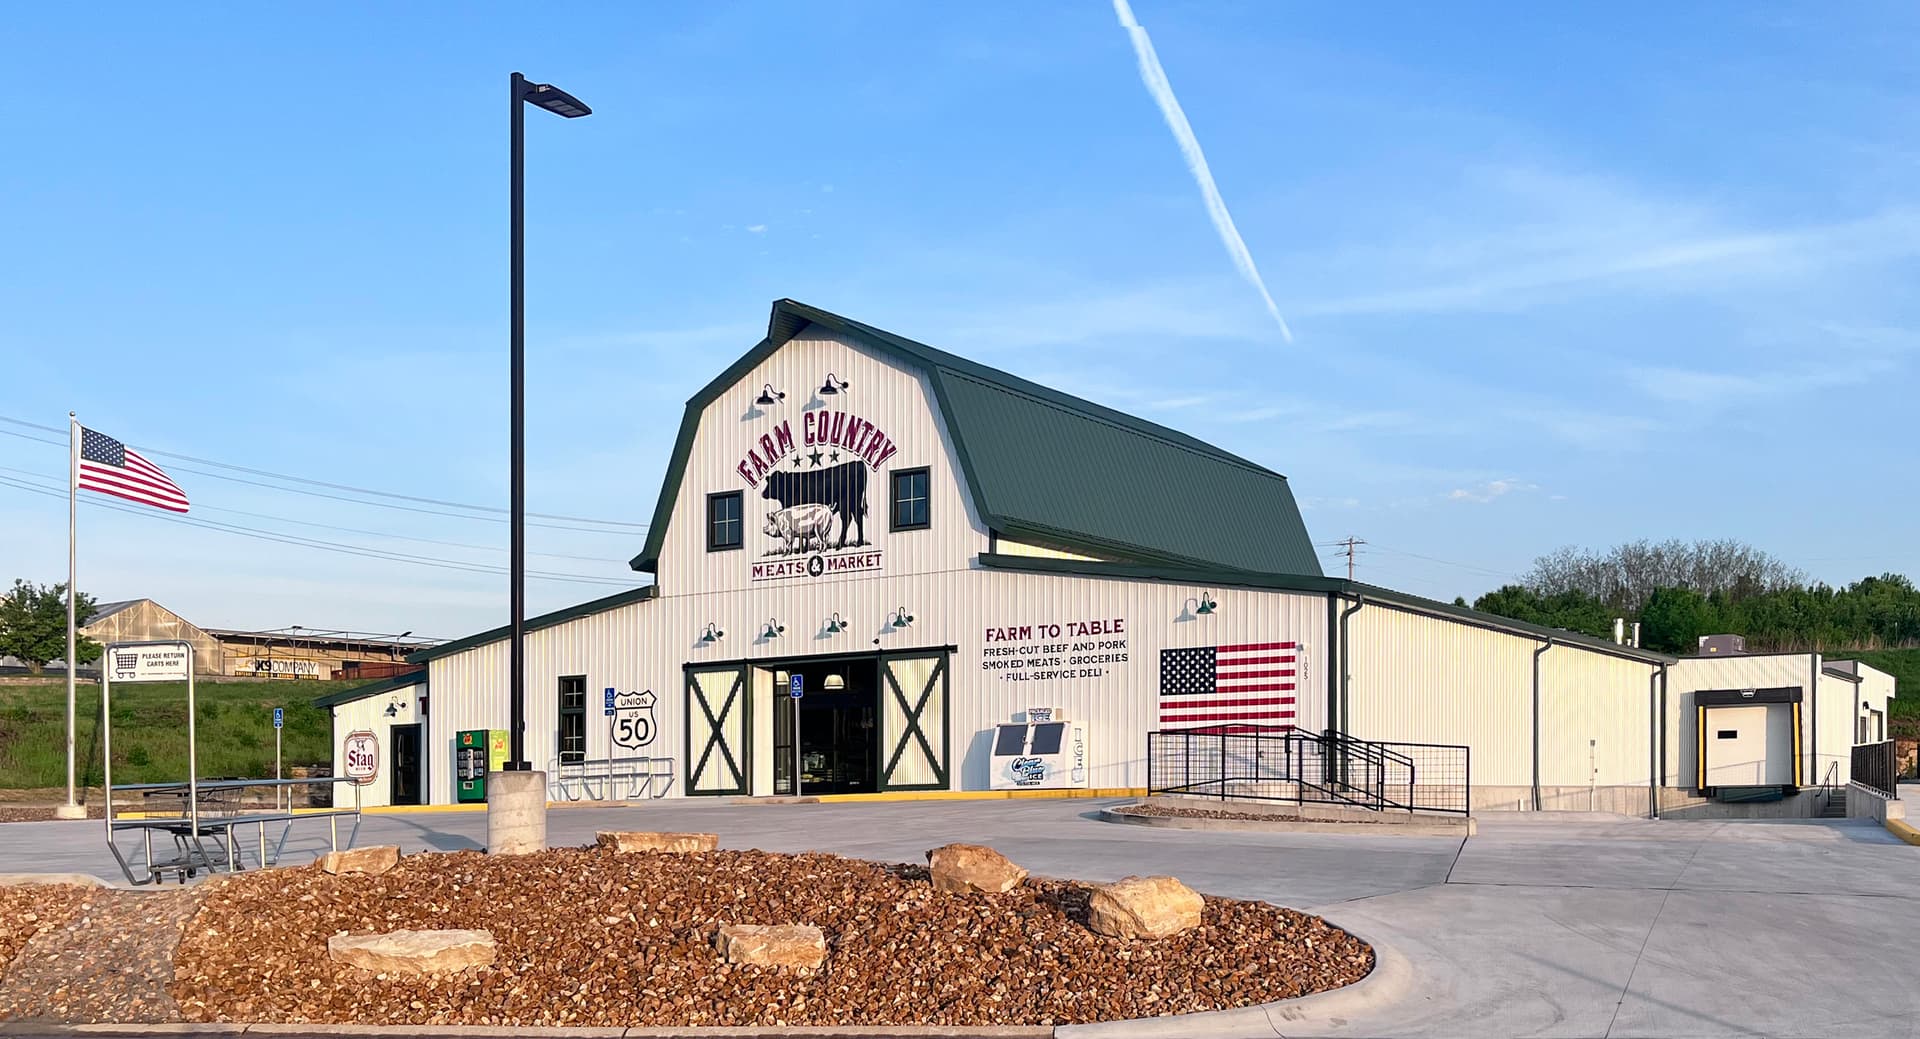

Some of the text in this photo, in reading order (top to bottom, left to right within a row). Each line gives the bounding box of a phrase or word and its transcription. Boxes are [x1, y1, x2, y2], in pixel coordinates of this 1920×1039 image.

[737, 410, 897, 489] FARM COUNTRY
[752, 554, 882, 578] MEATS & MARKET
[986, 619, 1124, 642] FARM TO TABLE
[983, 640, 1126, 657] FRESH-CUT BEEF AND PORK
[982, 653, 1128, 670] SMOKED MEATS GROCERIES
[1006, 668, 1102, 682] FULL-SERVICE DELI
[620, 697, 648, 706] UNION
[620, 718, 649, 741] 50
[348, 750, 374, 770] Stag
